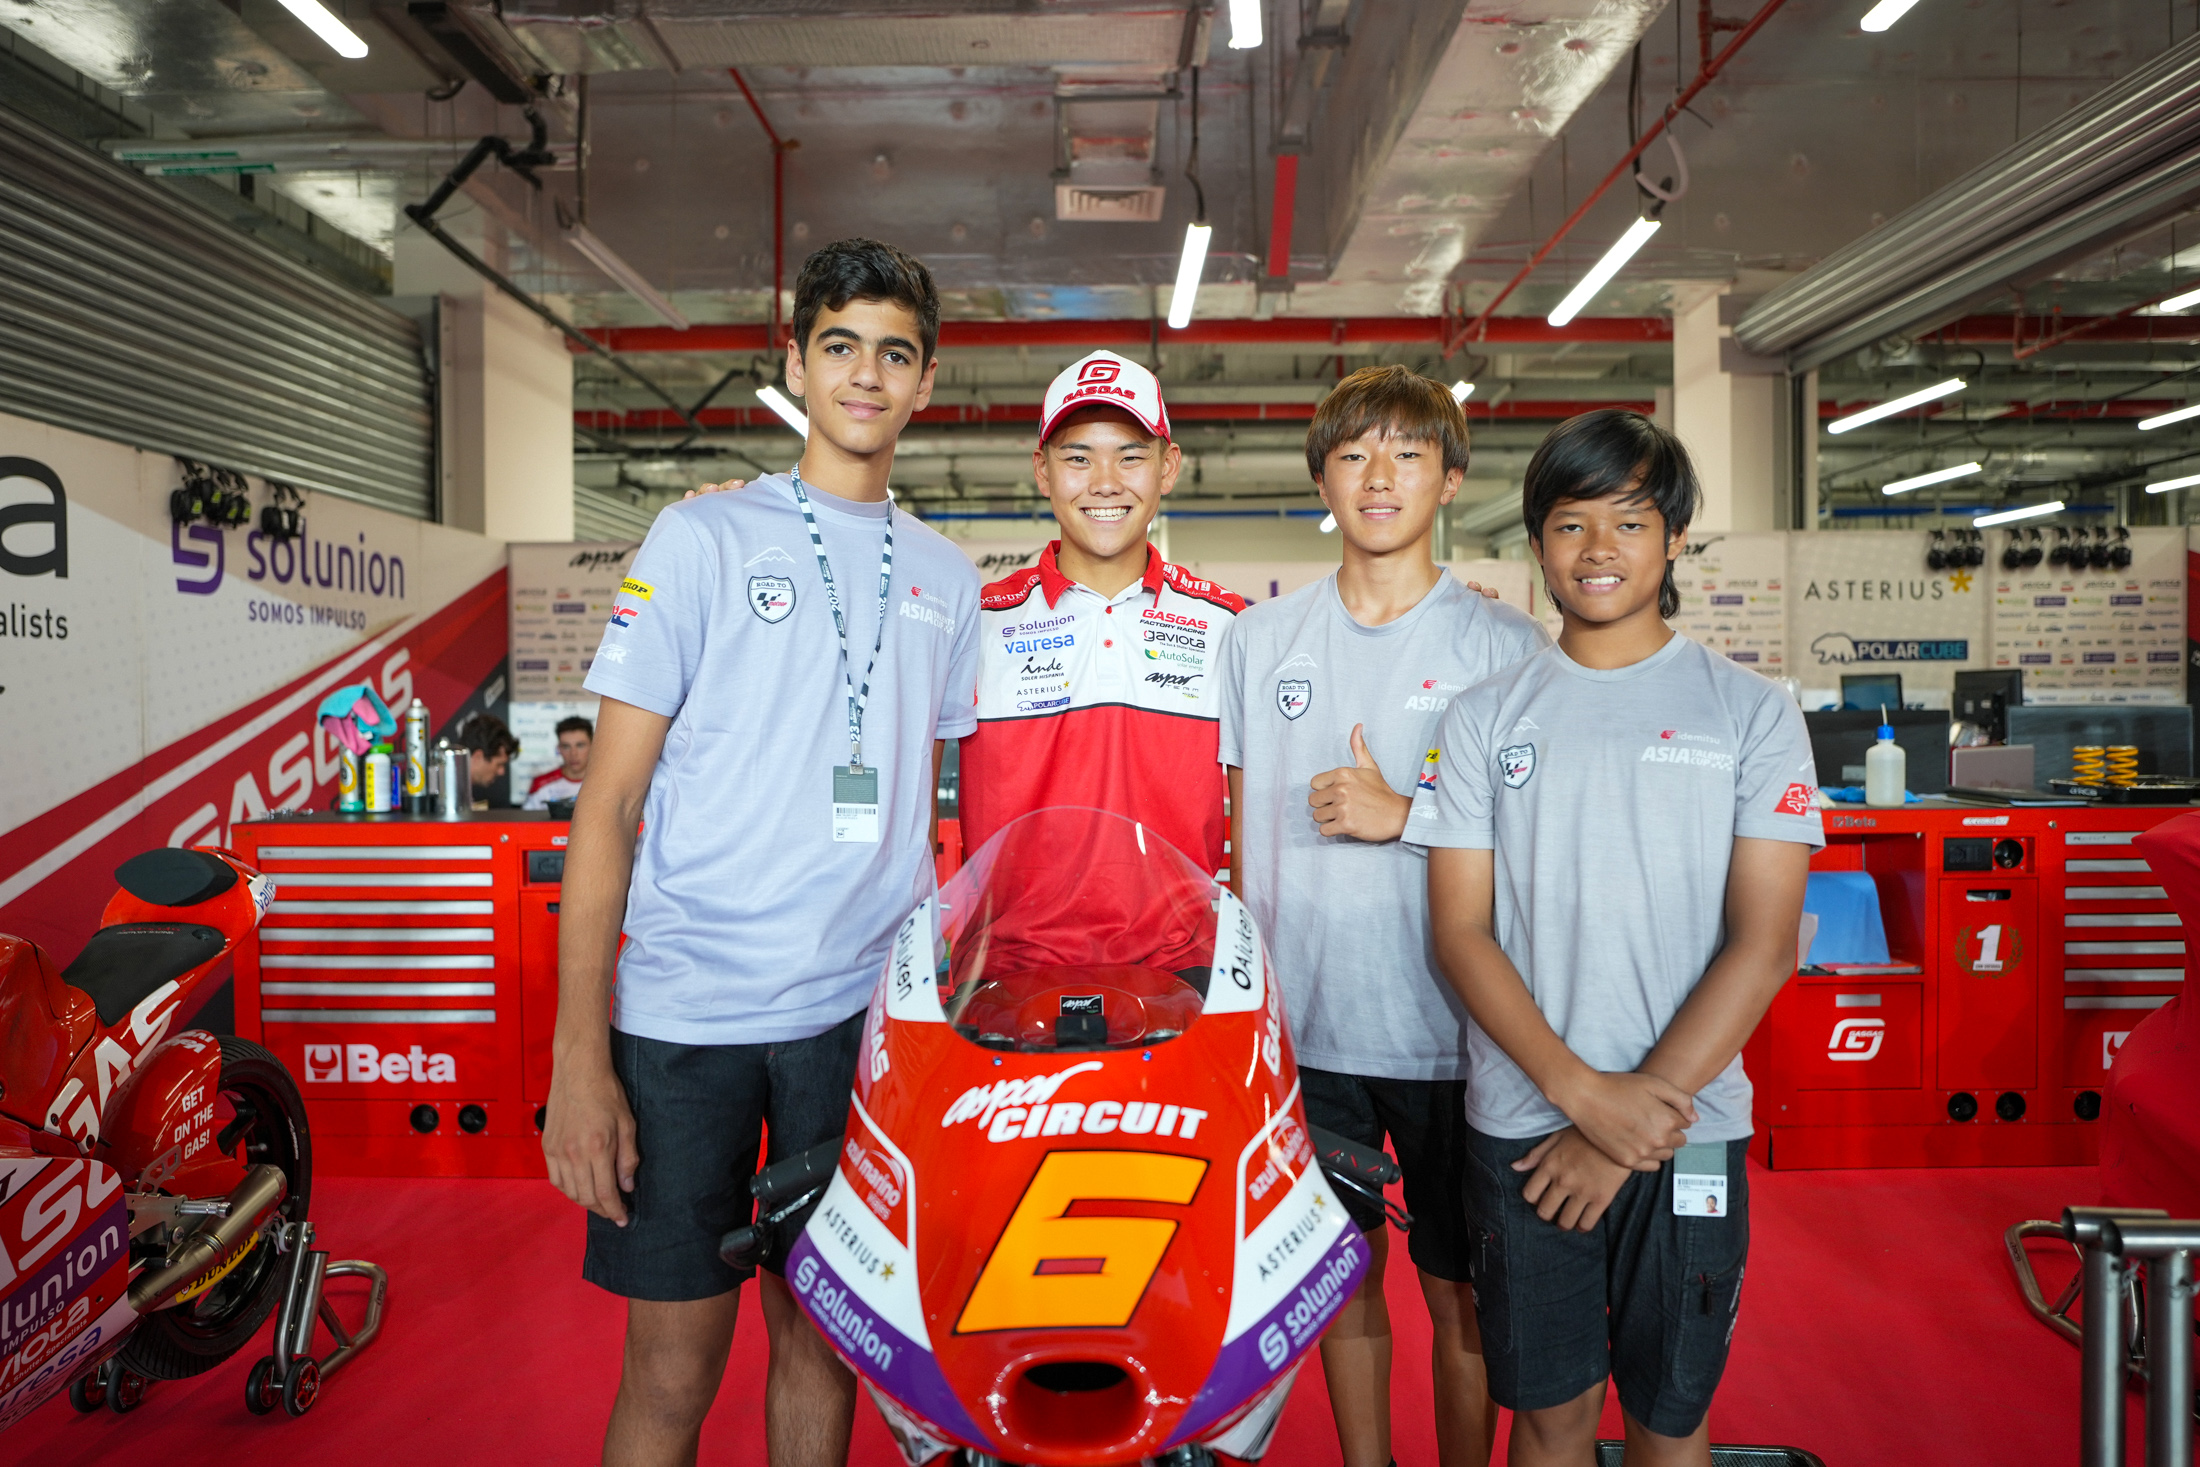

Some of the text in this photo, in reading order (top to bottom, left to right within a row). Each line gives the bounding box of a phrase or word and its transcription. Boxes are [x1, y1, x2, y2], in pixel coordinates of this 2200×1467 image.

[1063, 385, 1136, 404] GASGAS
[248, 517, 405, 600] solunion
[825, 582, 841, 612] 2023
[1804, 580, 1944, 601] ASTERIUS
[248, 600, 367, 631] SOMOS IMPULSO
[899, 601, 934, 625] ASIA
[1019, 615, 1075, 630] solunion
[1142, 609, 1208, 630] GASGAS
[1140, 619, 1206, 636] FACTORY RACING
[1143, 630, 1206, 649] gaviota
[1005, 634, 1075, 654] vairesa
[1857, 642, 1967, 660] POLARCUBE
[1020, 656, 1064, 675] inde
[1158, 650, 1204, 665] AutoSolar
[1016, 685, 1063, 696] ASTERIUS
[1144, 672, 1204, 689] aspar
[1404, 695, 1449, 713] ASIA
[1677, 731, 1721, 745] idemitsu
[1640, 746, 1690, 764] ASIA
[1690, 749, 1727, 762] TALENT
[1690, 757, 1711, 767] CUP
[1972, 924, 2004, 972] 1
[346, 1044, 457, 1083] Beta
[182, 1086, 205, 1112] GET
[941, 1060, 1104, 1130] aspar
[174, 1103, 214, 1144] ON THE
[987, 1100, 1208, 1142] CIRCUIT
[184, 1129, 210, 1160] GAS!
[846, 1137, 901, 1207] azul marino
[1248, 1158, 1279, 1201] azul
[822, 1205, 880, 1274] ASTERIUS
[952, 1148, 1210, 1336] 6
[1256, 1207, 1322, 1283] ASTERIUS
[1284, 1246, 1360, 1331] solunion
[3, 1300, 65, 1356] IMPULSO
[813, 1277, 893, 1371] solunion
[13, 1355, 45, 1383] Shutter
[46, 1319, 88, 1357] Specialists
